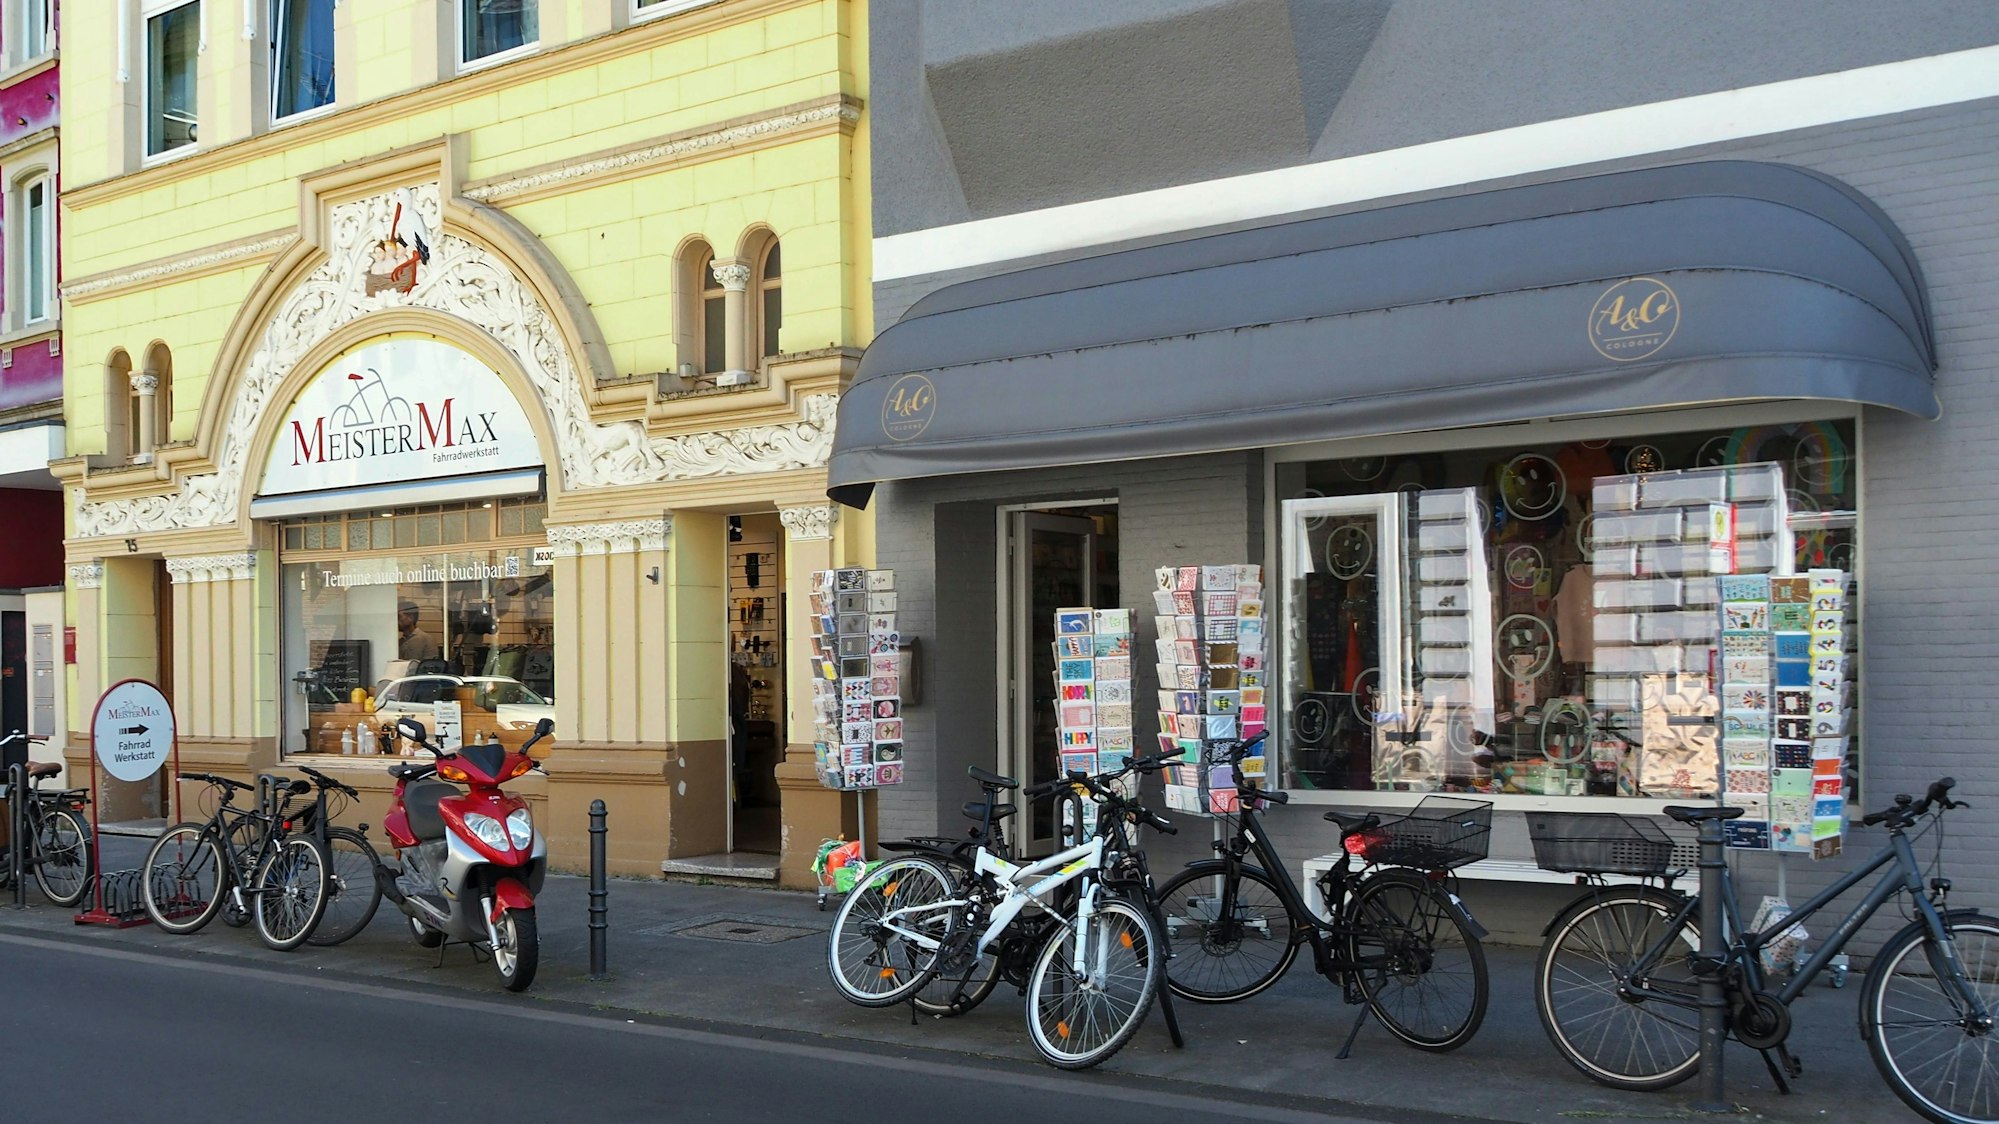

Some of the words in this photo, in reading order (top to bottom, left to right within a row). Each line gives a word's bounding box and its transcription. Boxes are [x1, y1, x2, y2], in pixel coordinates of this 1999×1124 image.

[1606, 338, 1659, 350] COLOGNE
[432, 446, 499, 464] Fahrradwerkstatt
[125, 538, 138, 552] 15
[322, 570, 373, 588] Termine
[374, 566, 403, 586] auch
[407, 564, 446, 583] online
[450, 560, 504, 580] buchbar
[118, 739, 151, 751] Fahrrad
[114, 751, 155, 763] Werkstatt
